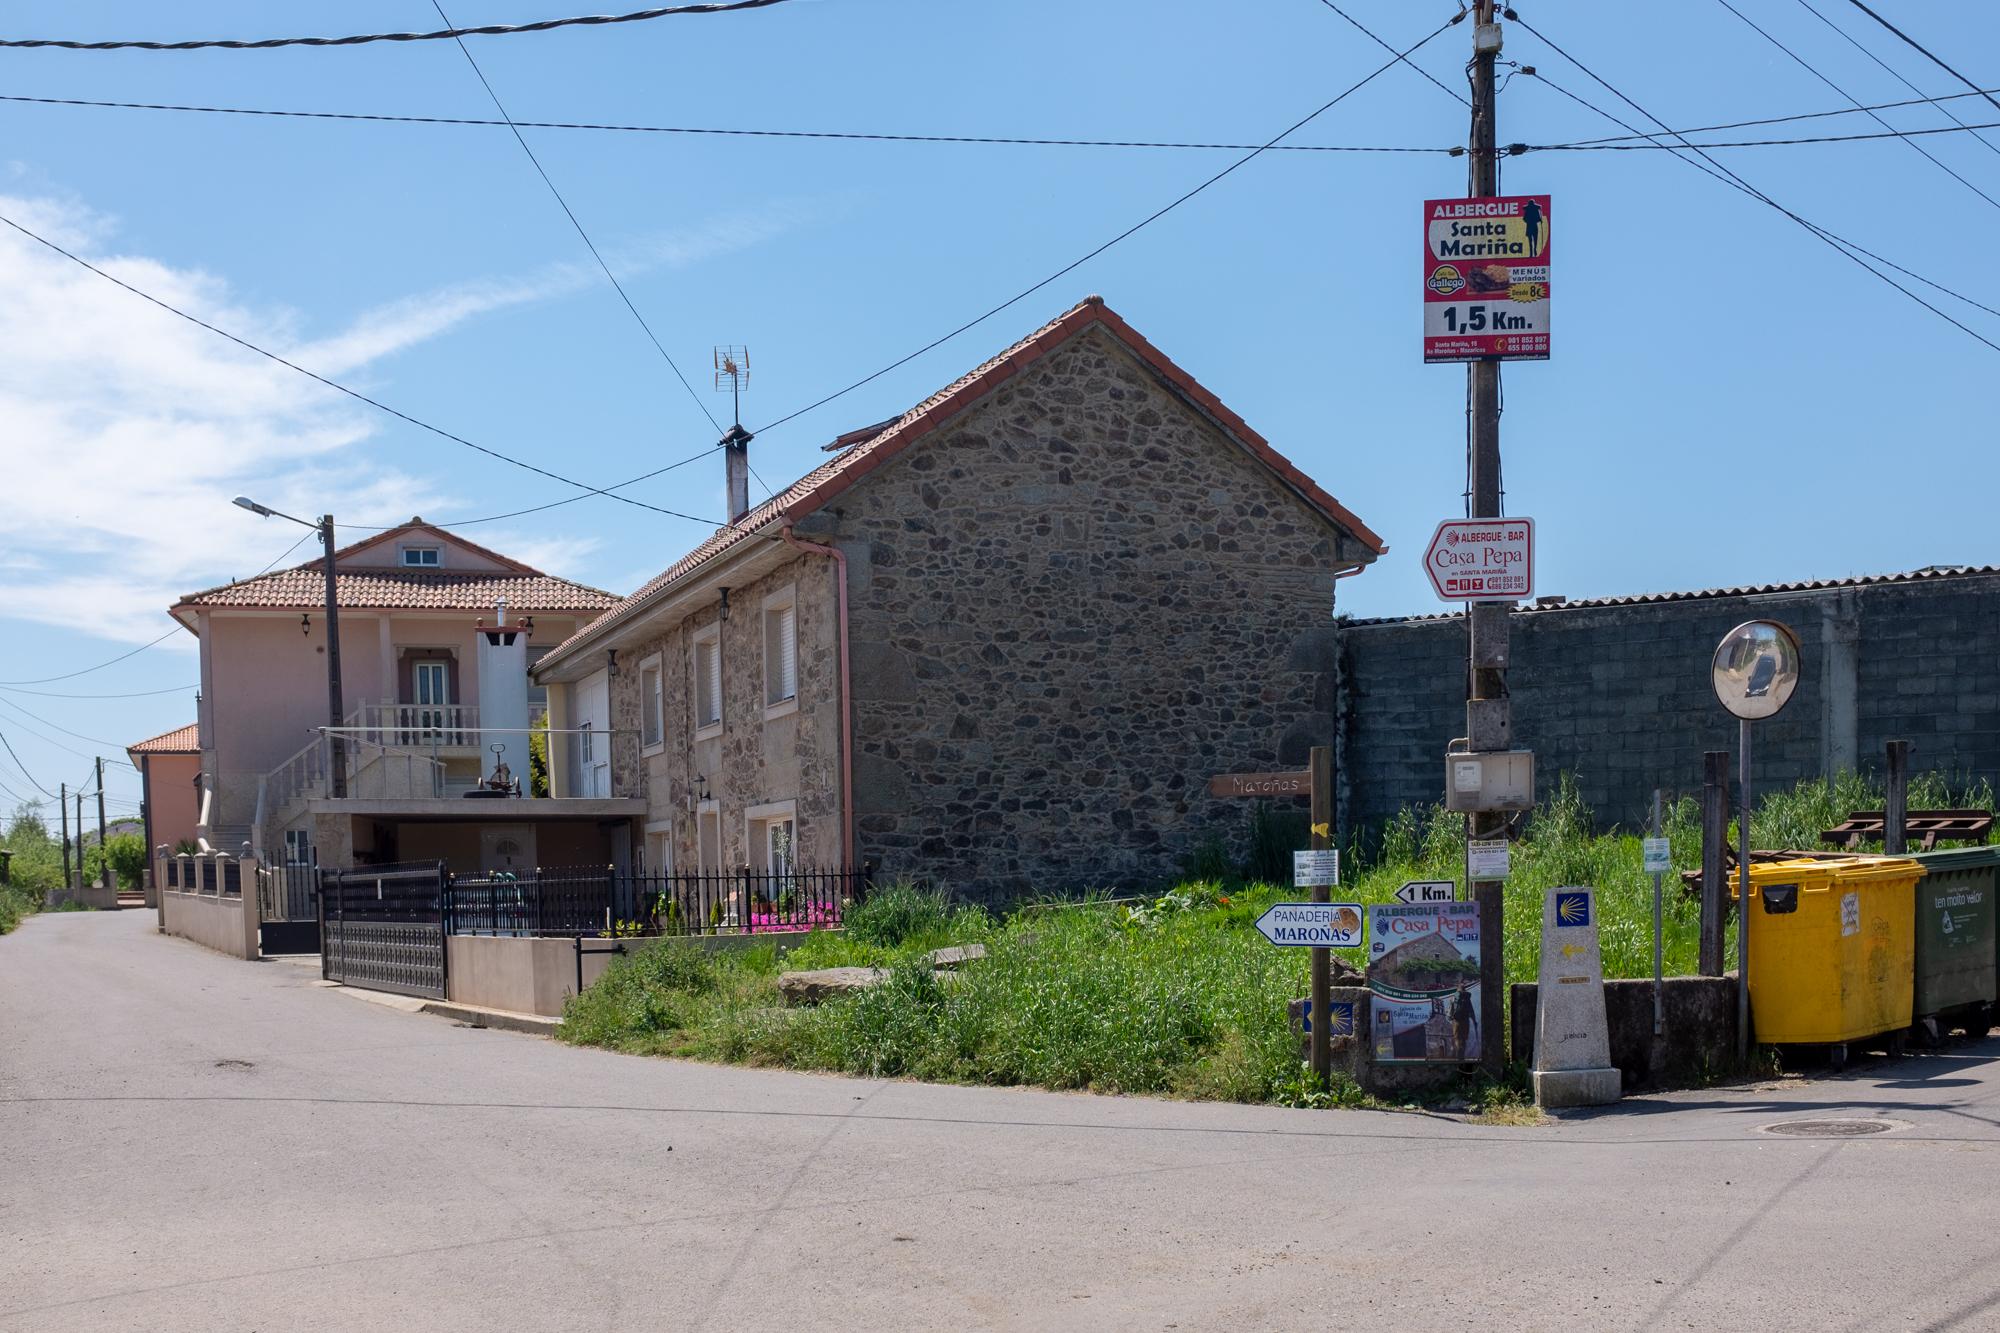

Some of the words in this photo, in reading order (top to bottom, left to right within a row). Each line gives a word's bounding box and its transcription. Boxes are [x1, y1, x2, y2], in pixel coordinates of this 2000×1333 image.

[1434, 202, 1518, 218] ALBERGUE
[1451, 222, 1506, 237] Santa
[1440, 239, 1523, 257] Mariña
[1430, 279, 1464, 288] Gallego
[1443, 306, 1486, 334] 1,5
[1492, 311, 1533, 330] Km.
[1461, 532, 1502, 543] ALBERGUE
[1508, 531, 1524, 541] BAR
[1435, 549, 1475, 568] Casa
[1483, 547, 1522, 567] Pepa
[1233, 777, 1299, 793] Maroñas
[1408, 888, 1414, 900] 1
[1422, 887, 1450, 900] Km.
[1935, 896, 1946, 908] ten
[1947, 893, 1965, 907] moito
[1966, 890, 1982, 904] valor
[1274, 908, 1341, 922] PANADERÍA
[1376, 906, 1440, 917] ALBERGUE
[1449, 906, 1474, 914] BAR
[1392, 918, 1429, 934] Casa
[1438, 913, 1473, 933] Pepa
[1274, 924, 1350, 942] MAROÑAS
